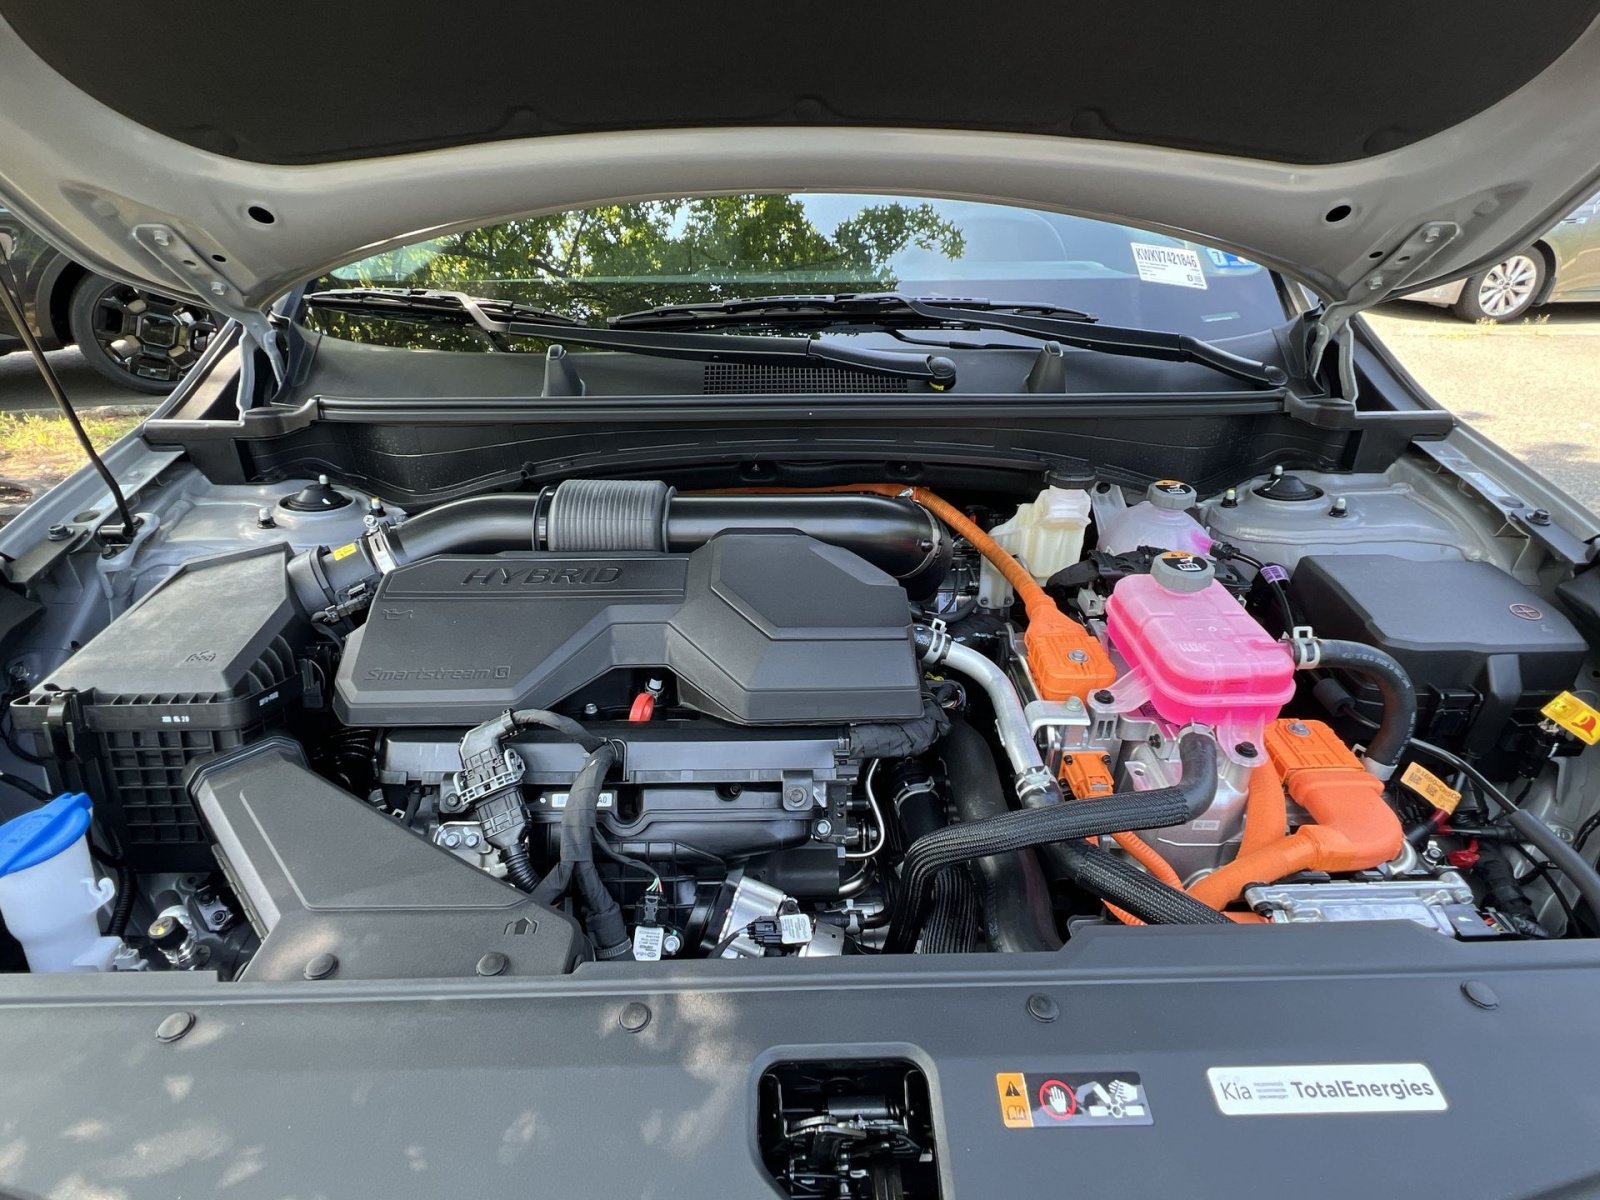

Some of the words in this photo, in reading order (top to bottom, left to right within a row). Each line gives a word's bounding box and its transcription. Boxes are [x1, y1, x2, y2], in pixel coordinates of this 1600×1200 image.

[460, 567, 624, 585] HYBRID
[364, 667, 491, 681] Smartstream
[1219, 1081, 1253, 1100] Kia
[1290, 1079, 1434, 1100] TotalEnergies
